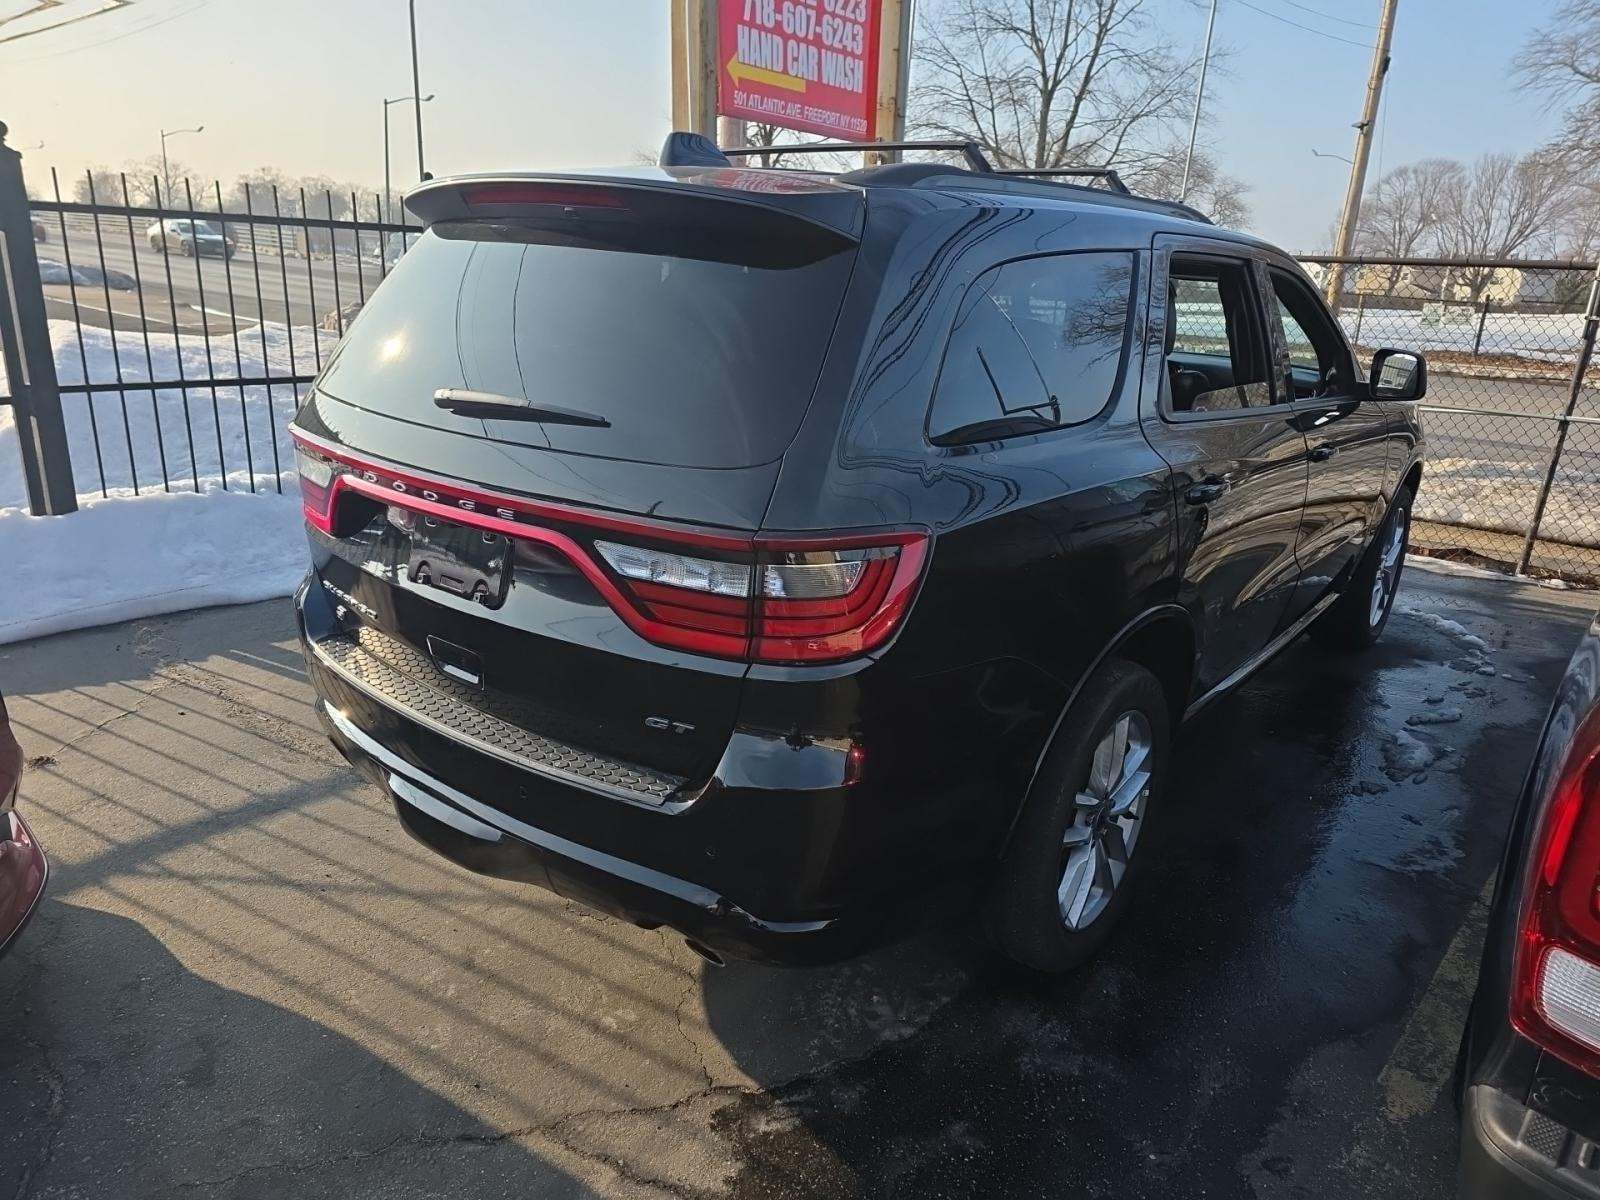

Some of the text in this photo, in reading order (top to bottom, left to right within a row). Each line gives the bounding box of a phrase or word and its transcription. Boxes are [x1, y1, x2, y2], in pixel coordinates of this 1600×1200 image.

[743, 0, 864, 55] 718-607-6243
[737, 24, 864, 94] HAND CAR WASH
[733, 90, 747, 107] 501
[748, 94, 786, 114] ATLANTIC
[362, 471, 515, 520] DODGE
[644, 716, 696, 734] GT
